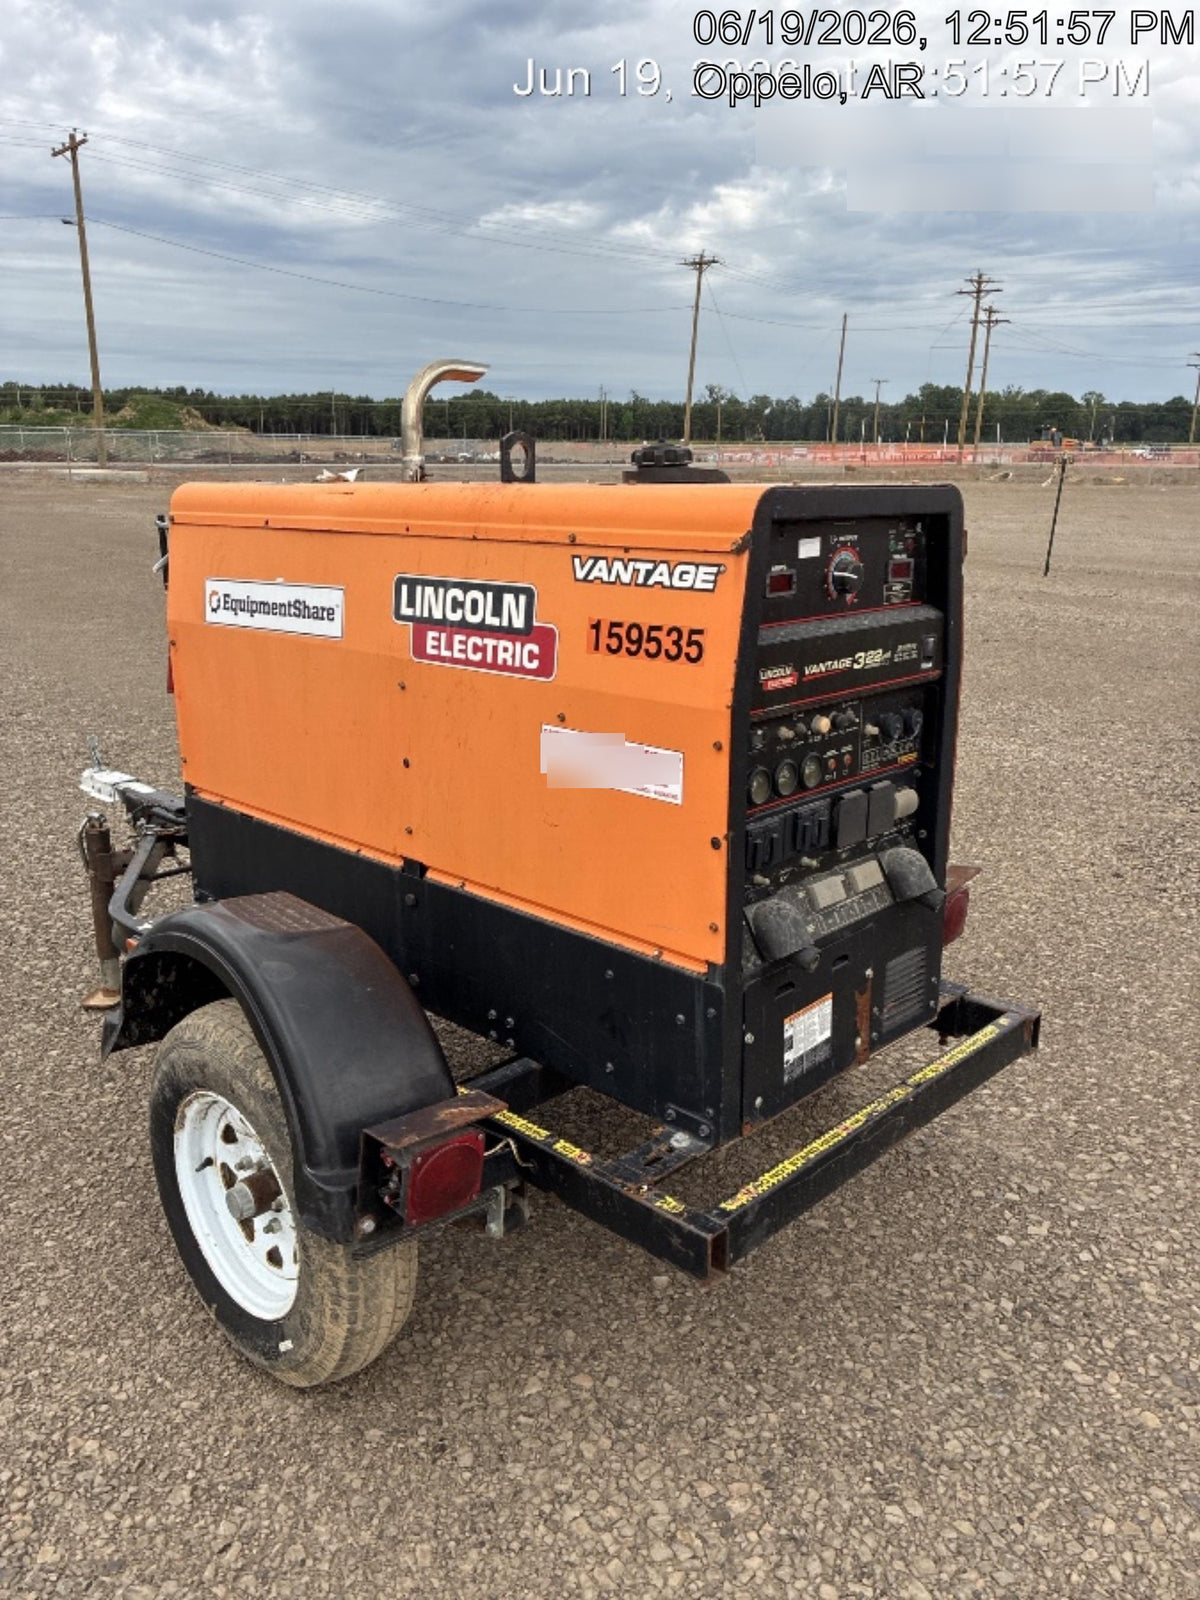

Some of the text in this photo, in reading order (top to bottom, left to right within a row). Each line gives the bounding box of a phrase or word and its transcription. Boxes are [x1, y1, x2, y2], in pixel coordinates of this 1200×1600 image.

[572, 555, 718, 592] VANTAGE
[222, 592, 335, 622] EquipmentShare
[399, 584, 526, 629] LINCOLN
[425, 630, 540, 670] ELECTRIC
[590, 618, 705, 664] 159535
[804, 656, 853, 675] VANTAGE
